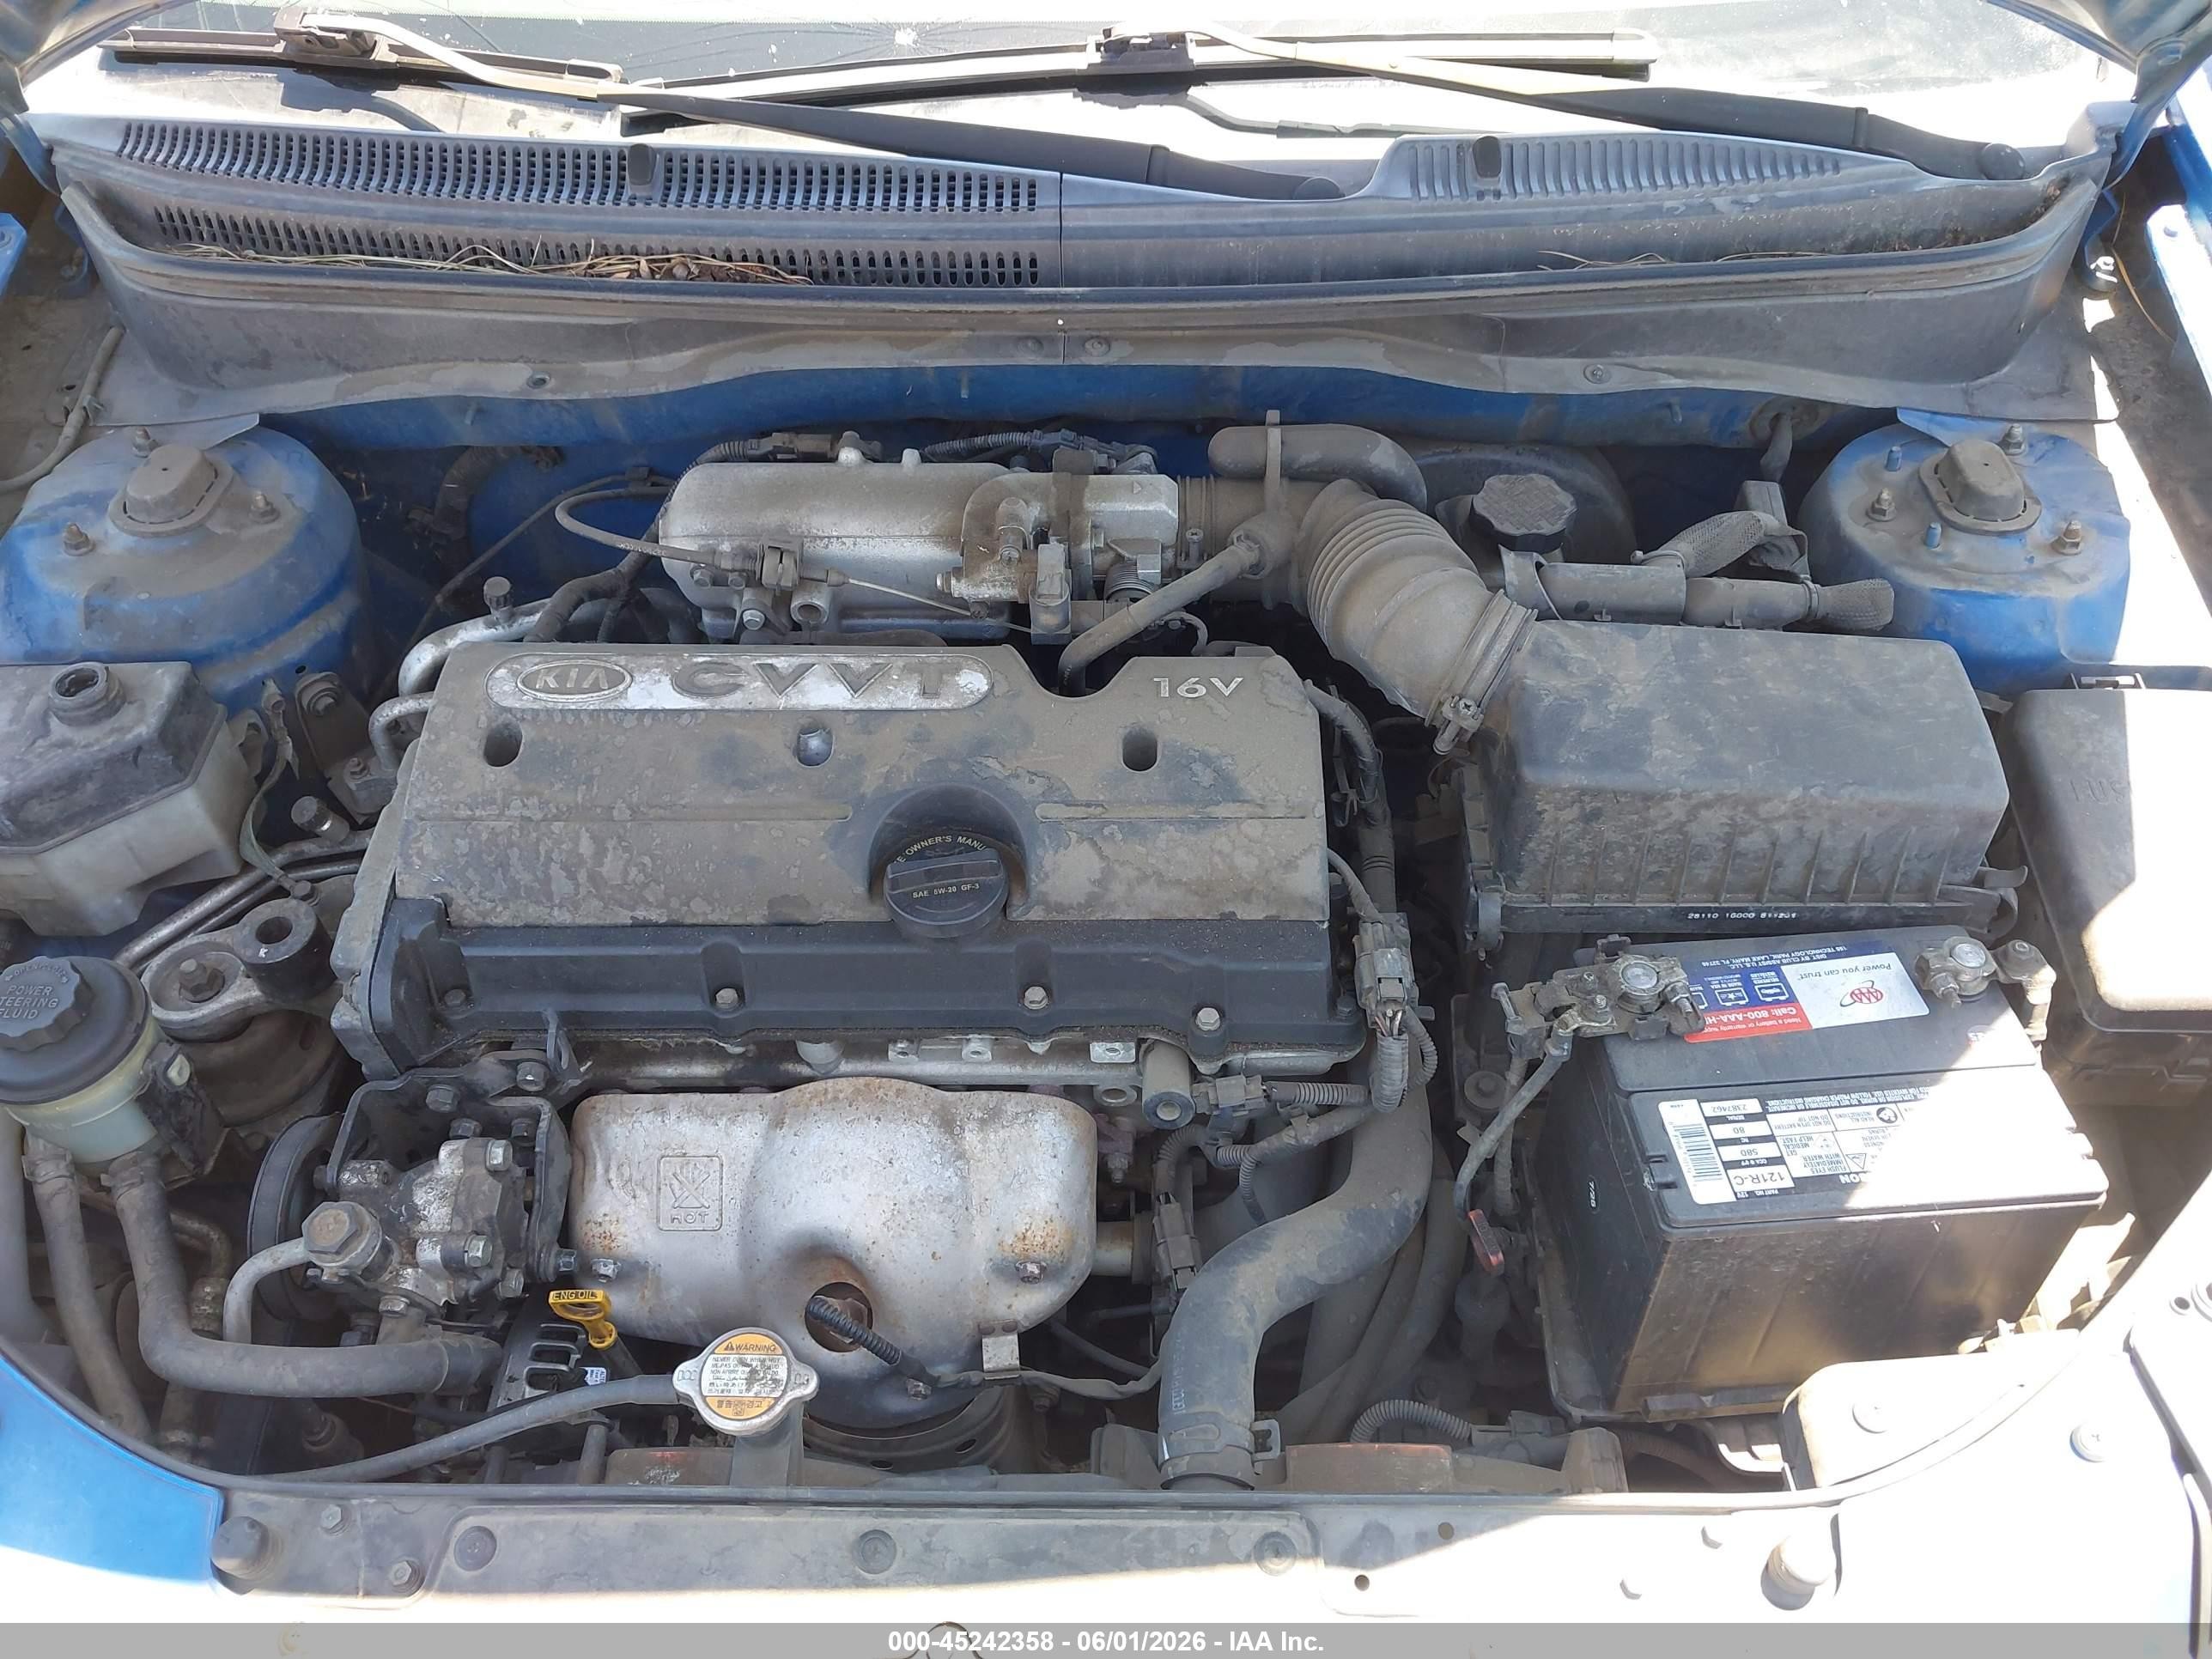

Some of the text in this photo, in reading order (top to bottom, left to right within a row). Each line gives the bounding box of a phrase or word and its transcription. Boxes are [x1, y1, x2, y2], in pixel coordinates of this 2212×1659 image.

[535, 667, 611, 690] KIA
[672, 660, 961, 699] CVVT
[1152, 677, 1244, 698] 16V
[905, 835, 952, 856] OWNER'S
[912, 890, 930, 899] SAE
[961, 883, 980, 892] GF-3
[1791, 947, 1836, 957] TECHNOLOGY
[1842, 965, 1860, 975] you
[1862, 963, 1892, 972] Power
[1798, 972, 1821, 981] trust
[7, 985, 52, 996] POWER
[1852, 988, 1881, 1003] AAA
[1770, 1006, 1796, 1017] Call:
[1740, 1147, 1759, 1157] 580
[1803, 1159, 1843, 1168] IMMEDIATELY
[1734, 1172, 1785, 1186] 121R-C
[671, 1211, 709, 1224] HOT
[552, 1290, 596, 1301] ENG OIL
[734, 1343, 776, 1352] WARNING
[747, 1401, 763, 1409] 경고
